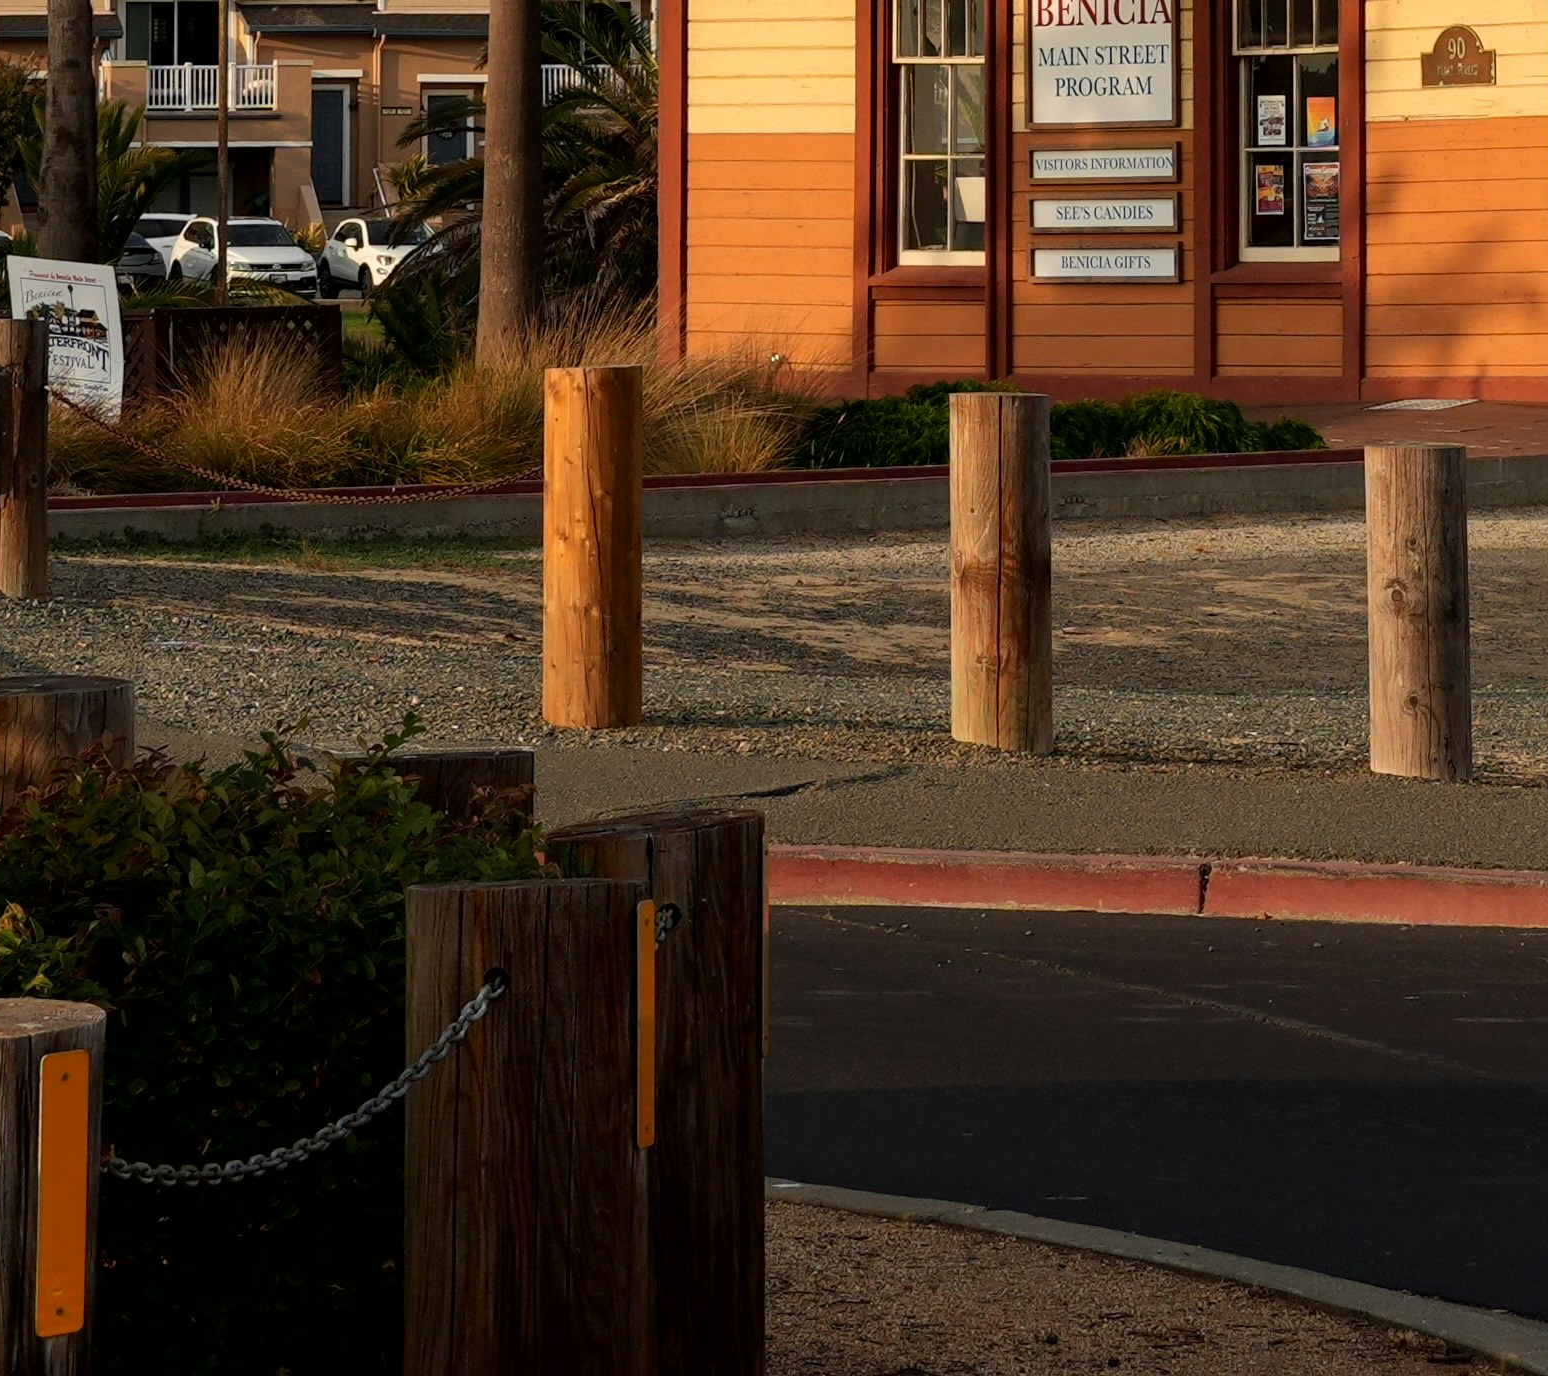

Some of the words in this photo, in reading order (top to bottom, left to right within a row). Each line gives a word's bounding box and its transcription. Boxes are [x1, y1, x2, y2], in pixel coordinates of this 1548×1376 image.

[1038, 46, 1090, 67] MAIN
[1094, 44, 1170, 66] STREET
[1447, 36, 1466, 60] 90
[1054, 76, 1154, 97] PROGRAM
[1035, 157, 1089, 171] VISITORS
[1091, 156, 1174, 171] INFORMATION
[1056, 205, 1091, 220] SEE'S
[1093, 205, 1154, 220] CANDIES
[1061, 255, 1112, 269] BENICIA
[1114, 255, 1151, 269] GIFTS
[25, 289, 63, 303] Benicia
